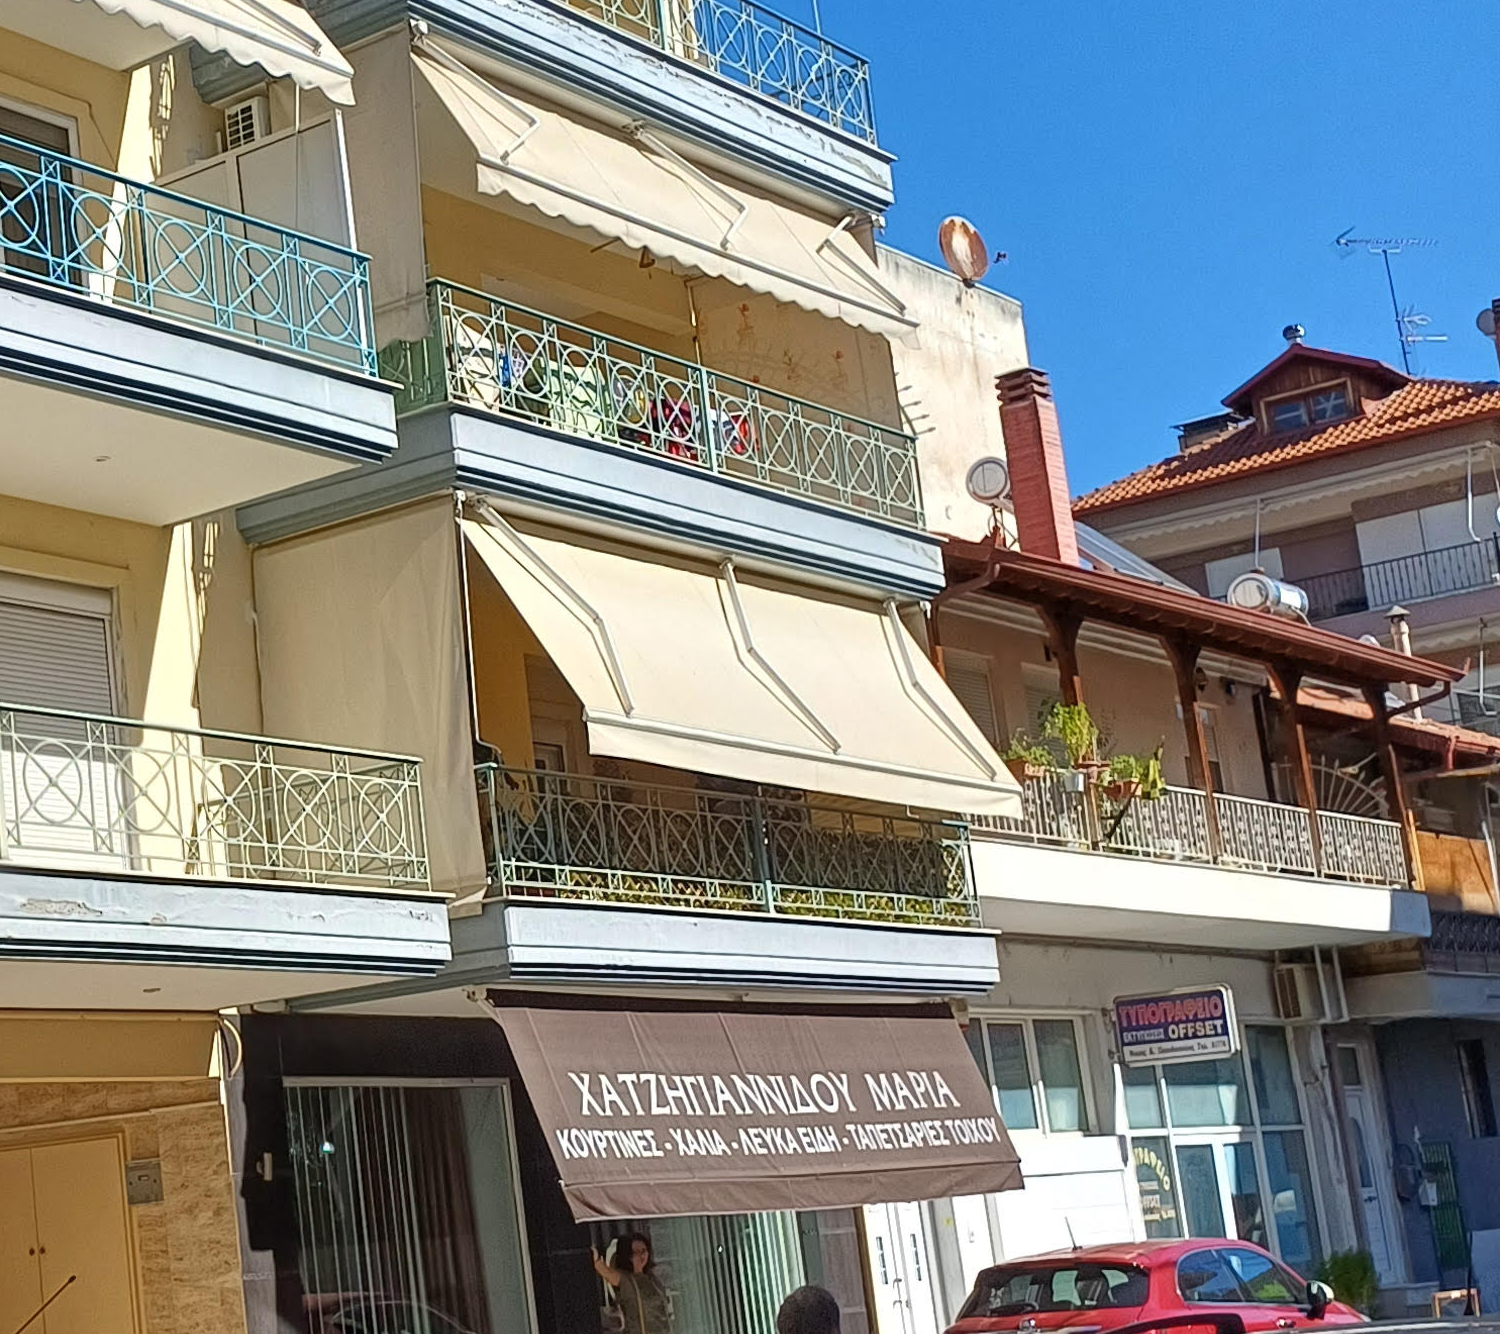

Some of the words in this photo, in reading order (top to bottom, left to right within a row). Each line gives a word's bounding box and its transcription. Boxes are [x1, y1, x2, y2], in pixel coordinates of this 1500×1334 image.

[1118, 995, 1223, 1028] ΤΥΠΟΓΡΑΦΕΙΟ
[1168, 1018, 1224, 1040] OFFSET
[567, 1071, 857, 1116] ΧΑΤΖΗΓΙΑΝΝΙΔΟΥ
[864, 1070, 961, 1112] ΜΑΡΙΑ
[555, 1127, 664, 1160] ΚΟΥΡΤΙΝΕΣ
[669, 1127, 732, 1156] ΧΑΛΙΑ
[738, 1126, 801, 1155] ΛΕΥΚΑ
[796, 1124, 843, 1154] ΕΙΔΗ
[846, 1118, 950, 1152] ΤΑΠΕΤΣΑΡΙΕΣ
[944, 1116, 1001, 1146] ΤΟΙΧΟΥ
